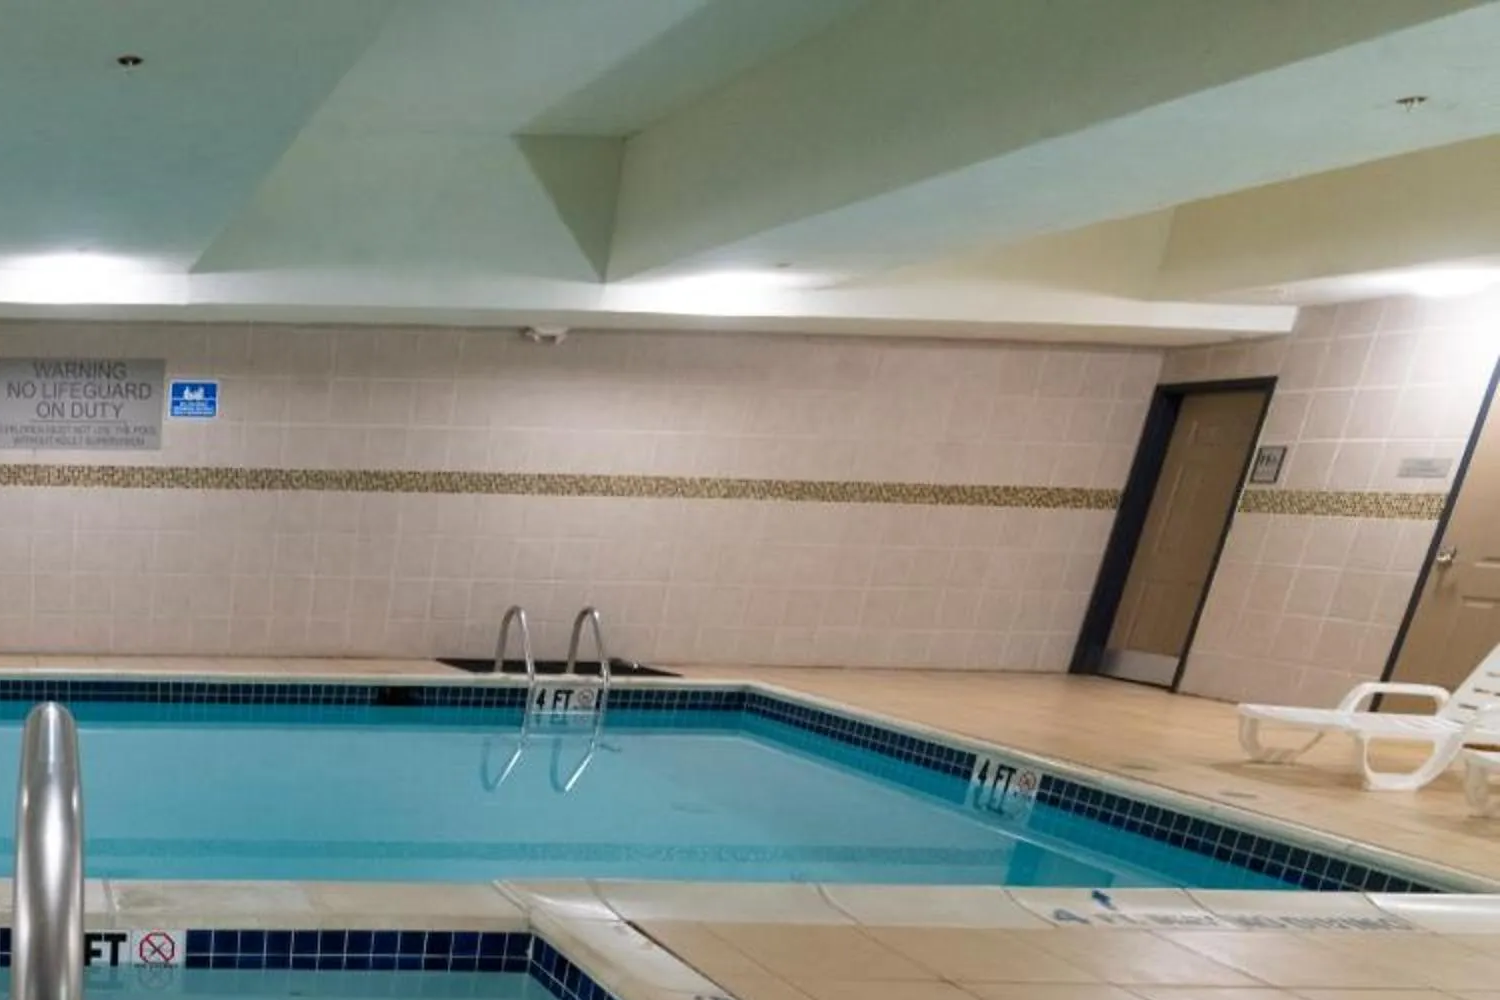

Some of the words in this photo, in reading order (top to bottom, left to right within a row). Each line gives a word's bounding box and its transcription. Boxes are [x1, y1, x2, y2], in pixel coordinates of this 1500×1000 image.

[32, 360, 128, 381] WARNING
[6, 381, 37, 400] NO
[41, 382, 152, 400] LIFEGUARD
[36, 401, 65, 419] ON
[71, 402, 125, 419] DUTY
[536, 688, 547, 711] 4
[552, 689, 574, 711] FT
[978, 759, 990, 786] 4
[993, 764, 1017, 794] FT
[84, 932, 127, 967] FT
